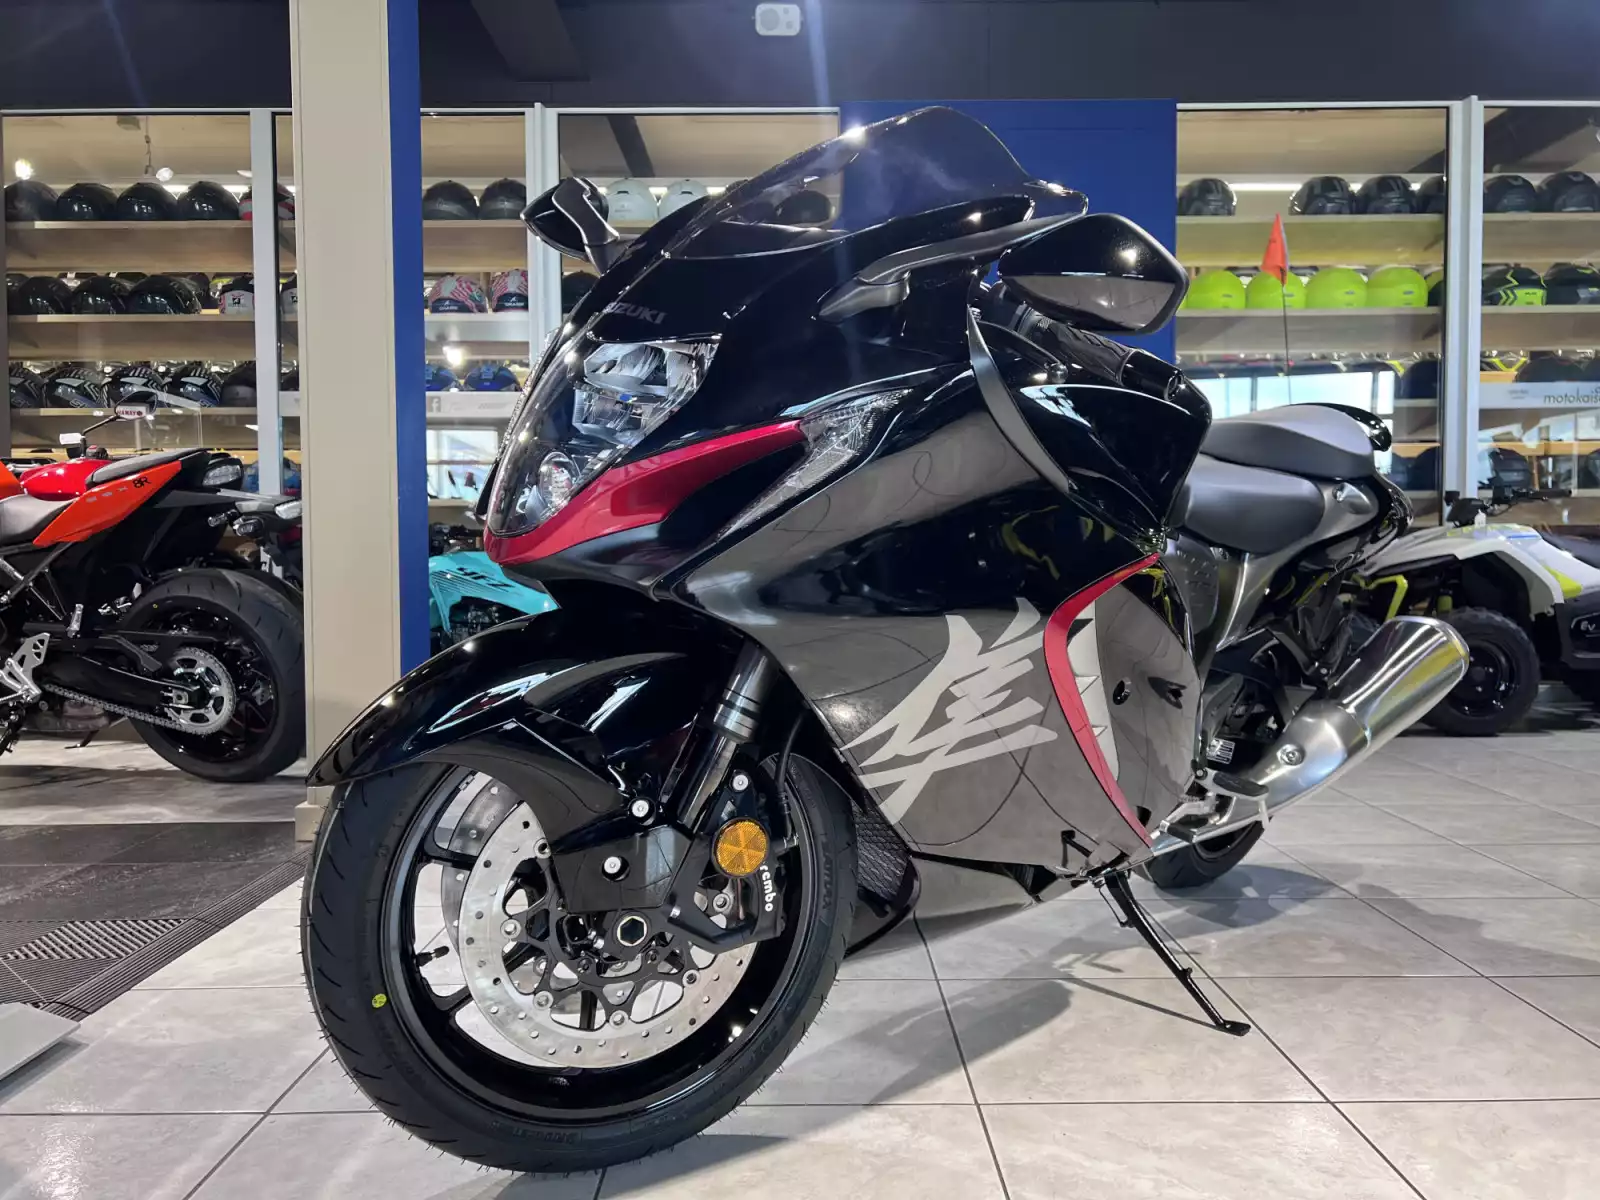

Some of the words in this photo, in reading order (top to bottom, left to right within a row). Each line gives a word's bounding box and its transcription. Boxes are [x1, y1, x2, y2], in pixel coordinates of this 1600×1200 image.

[1543, 387, 1600, 405] motokais
[132, 476, 151, 488] 8R
[760, 862, 776, 912] rembo
